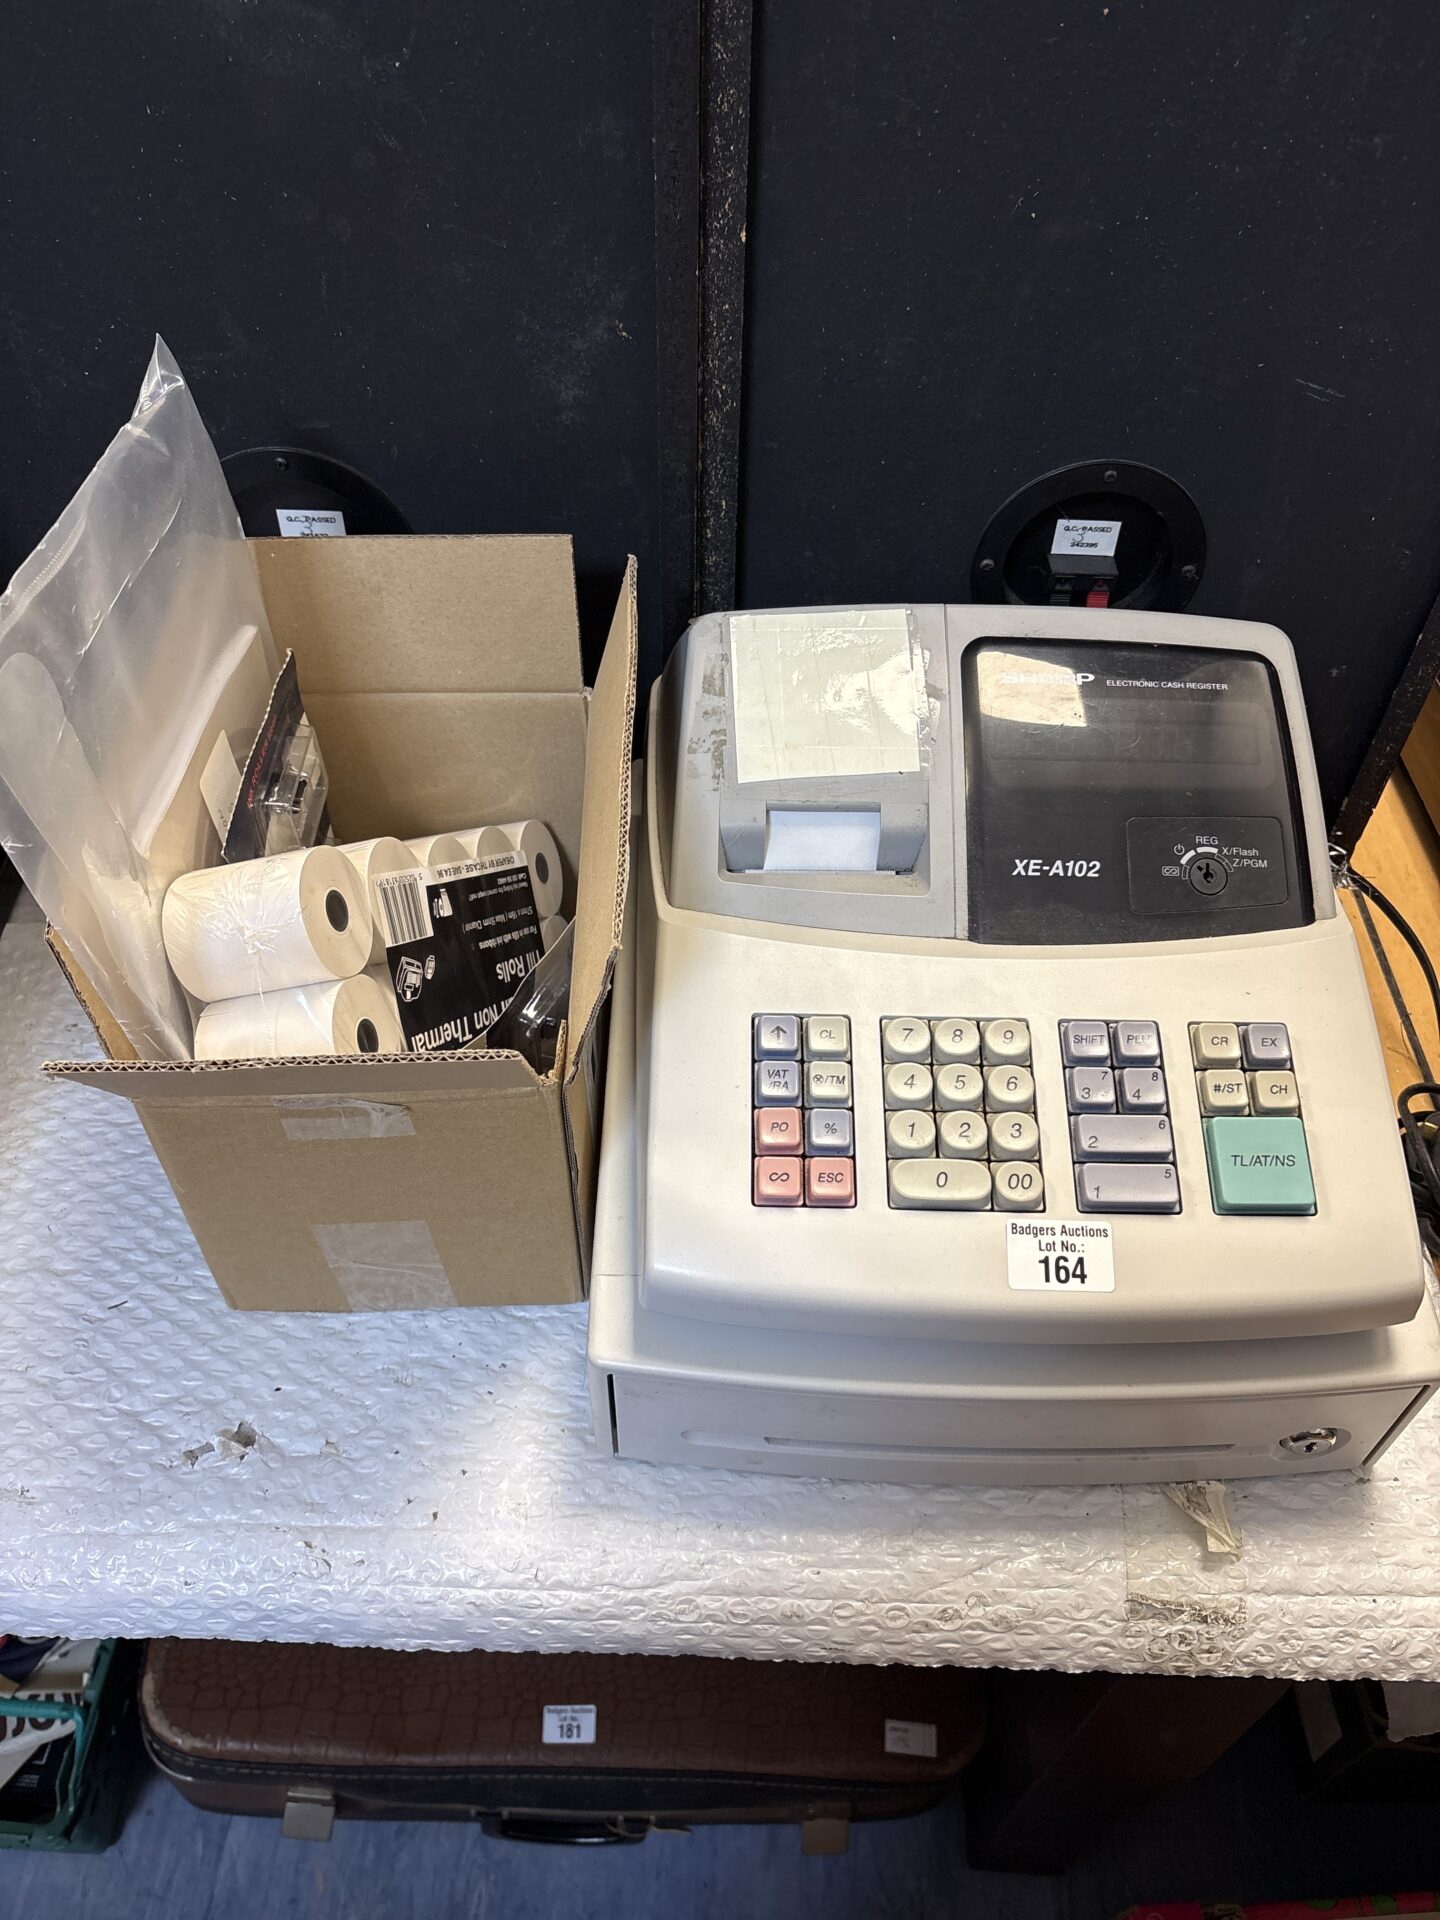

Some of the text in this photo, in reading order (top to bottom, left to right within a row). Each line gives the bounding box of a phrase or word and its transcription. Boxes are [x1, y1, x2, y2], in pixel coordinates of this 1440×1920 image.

[1002, 672, 1228, 691] SHARP ELECTRONIC CASH REGISTER
[1195, 835, 1219, 846] REG
[1222, 846, 1260, 858] X/Flash
[1012, 858, 1101, 878] XE-A102
[1232, 858, 1268, 870] Z/PGM
[496, 956, 526, 983] Rolls
[474, 1004, 498, 1029] Non
[412, 1016, 472, 1052] Thermal
[819, 1028, 836, 1040] CL
[902, 1028, 914, 1042] 7
[952, 1028, 963, 1042] 8
[1003, 1030, 1014, 1044] 9
[1073, 1034, 1106, 1044] SHIFT
[1211, 1036, 1229, 1046] CR
[1261, 1038, 1278, 1048] EX
[766, 1070, 788, 1079] VAT
[1100, 1072, 1108, 1081] 7
[1151, 1072, 1158, 1082] 8
[904, 1075, 915, 1089] 4
[954, 1075, 966, 1090] 5
[1006, 1076, 1018, 1091] 6
[1212, 1082, 1242, 1094] #/ST
[1081, 1087, 1092, 1100] 3
[1132, 1088, 1142, 1100] 4
[1270, 1084, 1288, 1095] CH
[770, 1122, 788, 1132] PO
[824, 1123, 838, 1134] %
[908, 1123, 916, 1138] 1
[958, 1122, 970, 1138] 2
[1010, 1123, 1022, 1138] 3
[1158, 1120, 1166, 1130] 6
[1088, 1136, 1098, 1148] 2
[1231, 1154, 1296, 1167] TL/AT/NS
[818, 1172, 844, 1184] ESC
[1164, 1169, 1172, 1178] 5
[936, 1172, 948, 1188] 0
[1008, 1174, 1033, 1190] 00
[1094, 1186, 1100, 1198] 1
[1011, 1222, 1108, 1238] Badgers Auctions
[1038, 1240, 1084, 1252] Lot No.:
[1038, 1256, 1088, 1284] 164
[558, 1723, 582, 1738] 181
